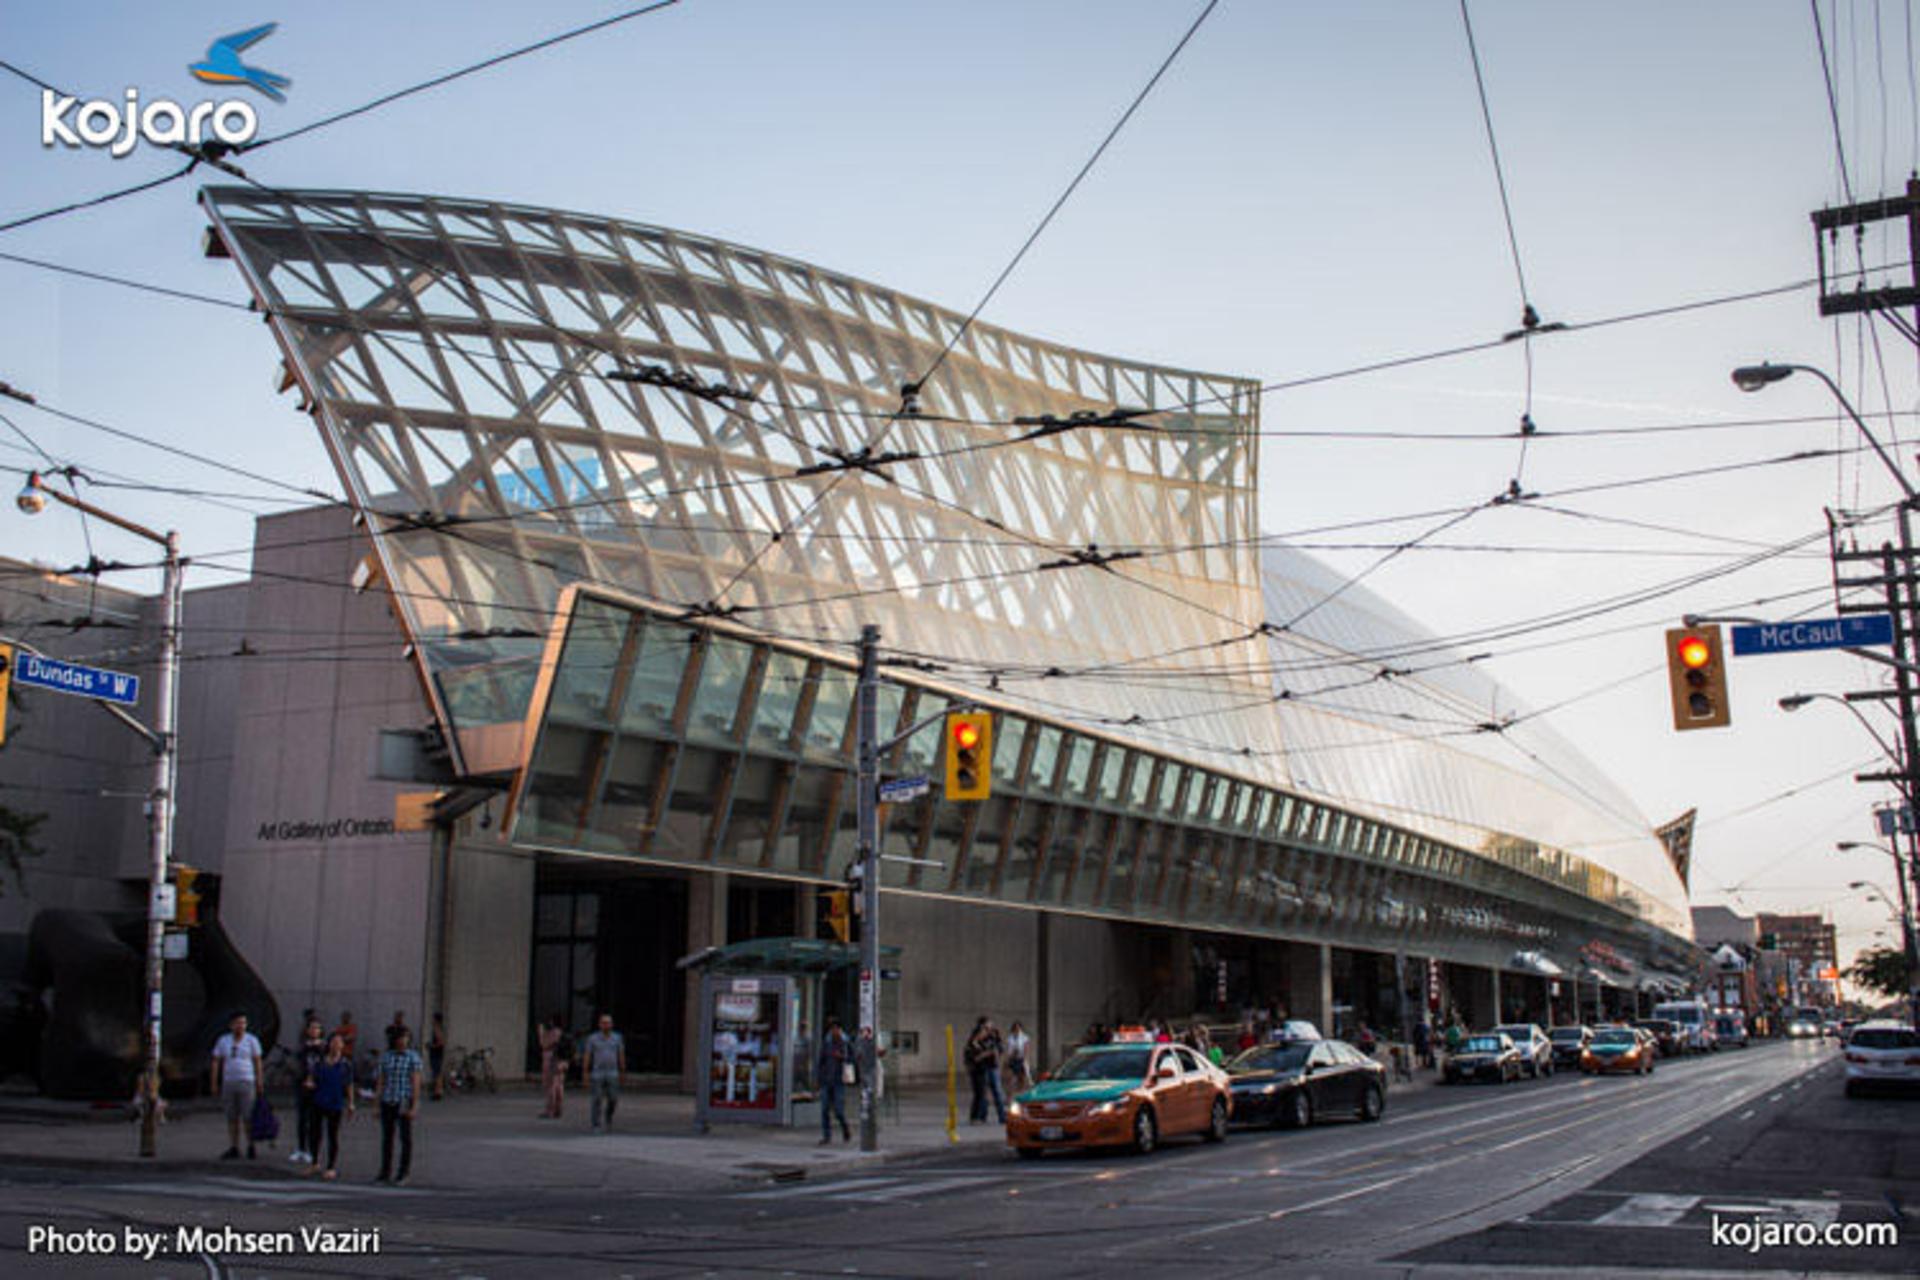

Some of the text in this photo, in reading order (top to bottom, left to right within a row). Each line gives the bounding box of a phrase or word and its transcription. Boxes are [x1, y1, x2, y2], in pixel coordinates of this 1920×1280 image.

[1760, 621, 1844, 647] McCaul
[27, 657, 93, 690] Dundas
[114, 676, 129, 695] W
[258, 821, 276, 840] Art
[278, 820, 326, 841] Gallery
[327, 818, 342, 838] of
